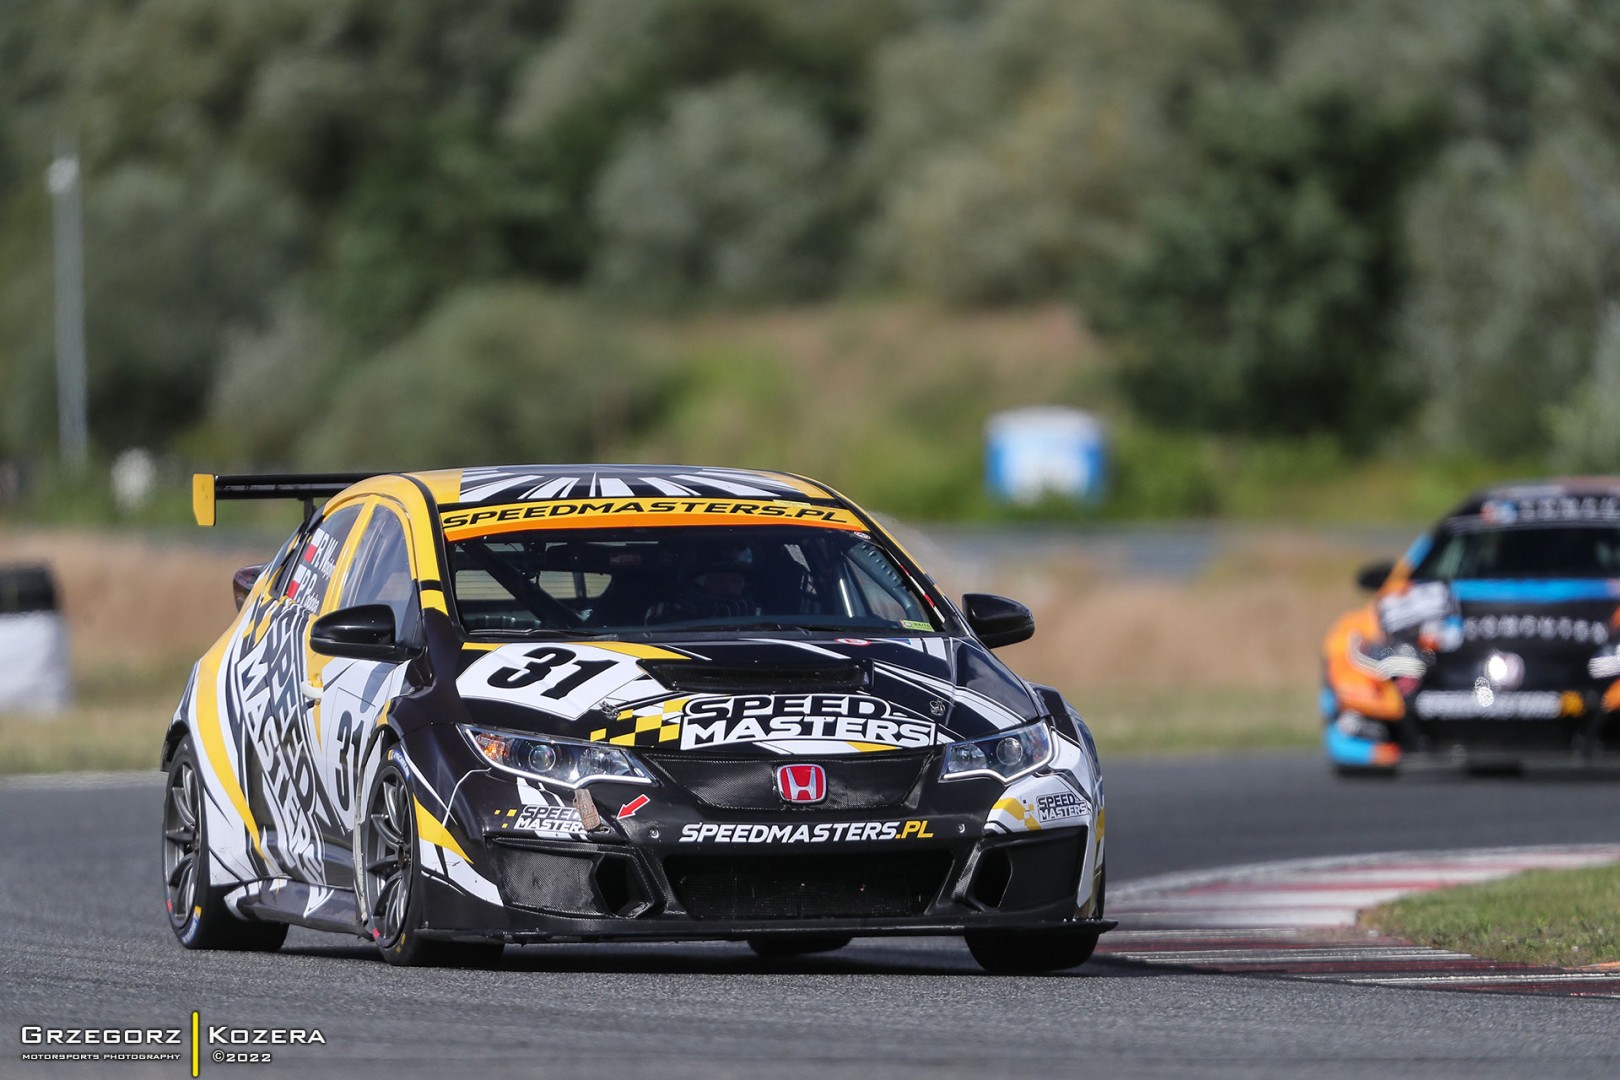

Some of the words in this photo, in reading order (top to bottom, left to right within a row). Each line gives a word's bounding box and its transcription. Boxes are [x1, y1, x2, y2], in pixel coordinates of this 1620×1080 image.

[443, 502, 848, 529] SPEEDMASTERS.PL
[487, 646, 620, 700] 31
[688, 695, 887, 718] SPEED
[680, 715, 931, 750] MASTERS
[335, 710, 364, 812] 31
[1039, 793, 1076, 809] SPEED
[1039, 804, 1088, 821] MASTERS
[514, 817, 586, 833] MASTER
[679, 821, 934, 844] SPEEDMASTERS.PL
